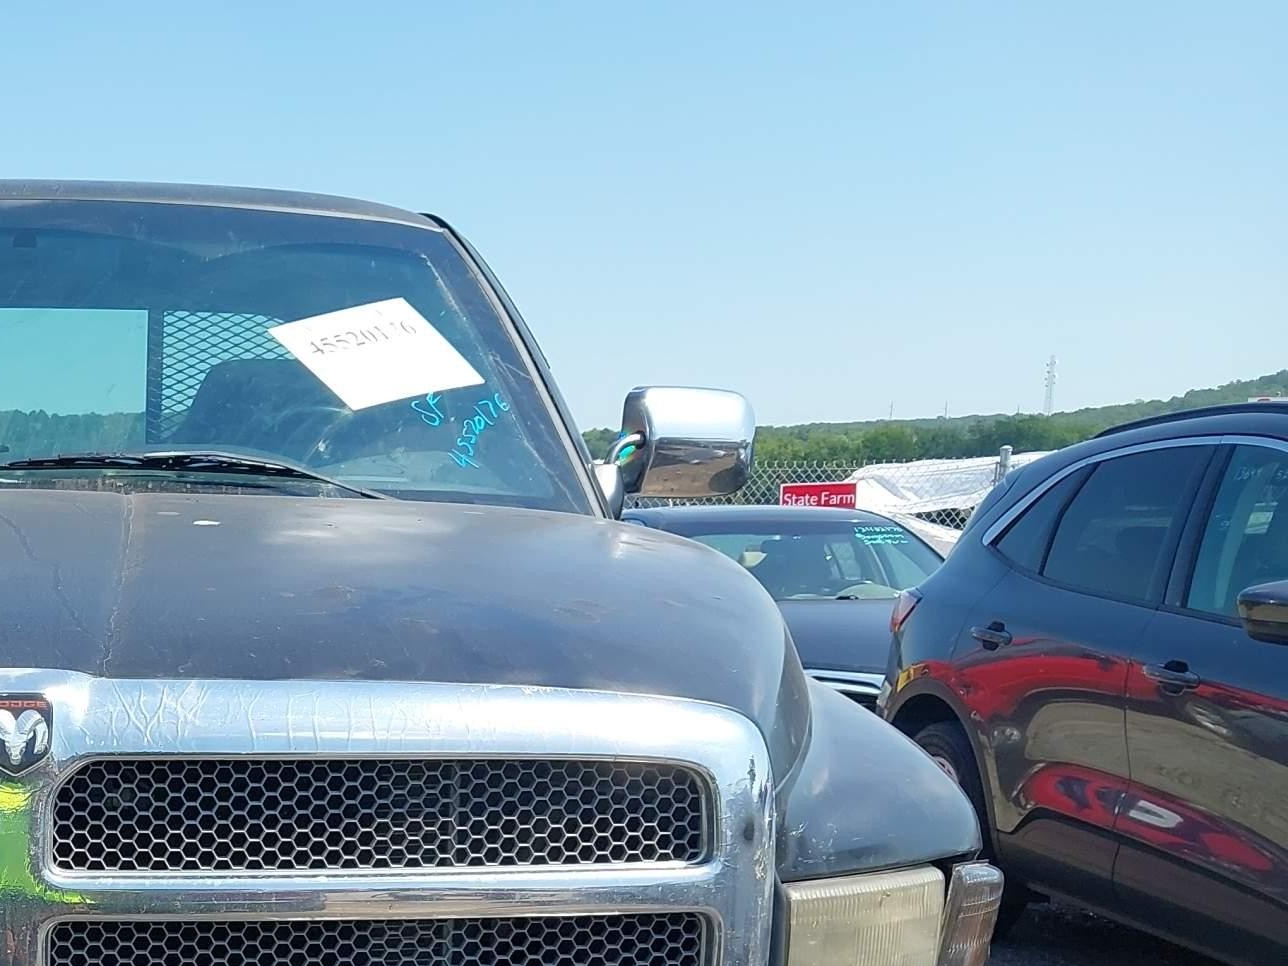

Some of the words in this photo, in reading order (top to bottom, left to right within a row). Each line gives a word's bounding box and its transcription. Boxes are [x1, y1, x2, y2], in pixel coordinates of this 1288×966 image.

[447, 392, 511, 469] 45520176
[783, 493, 819, 507] State
[820, 491, 855, 506] Farm
